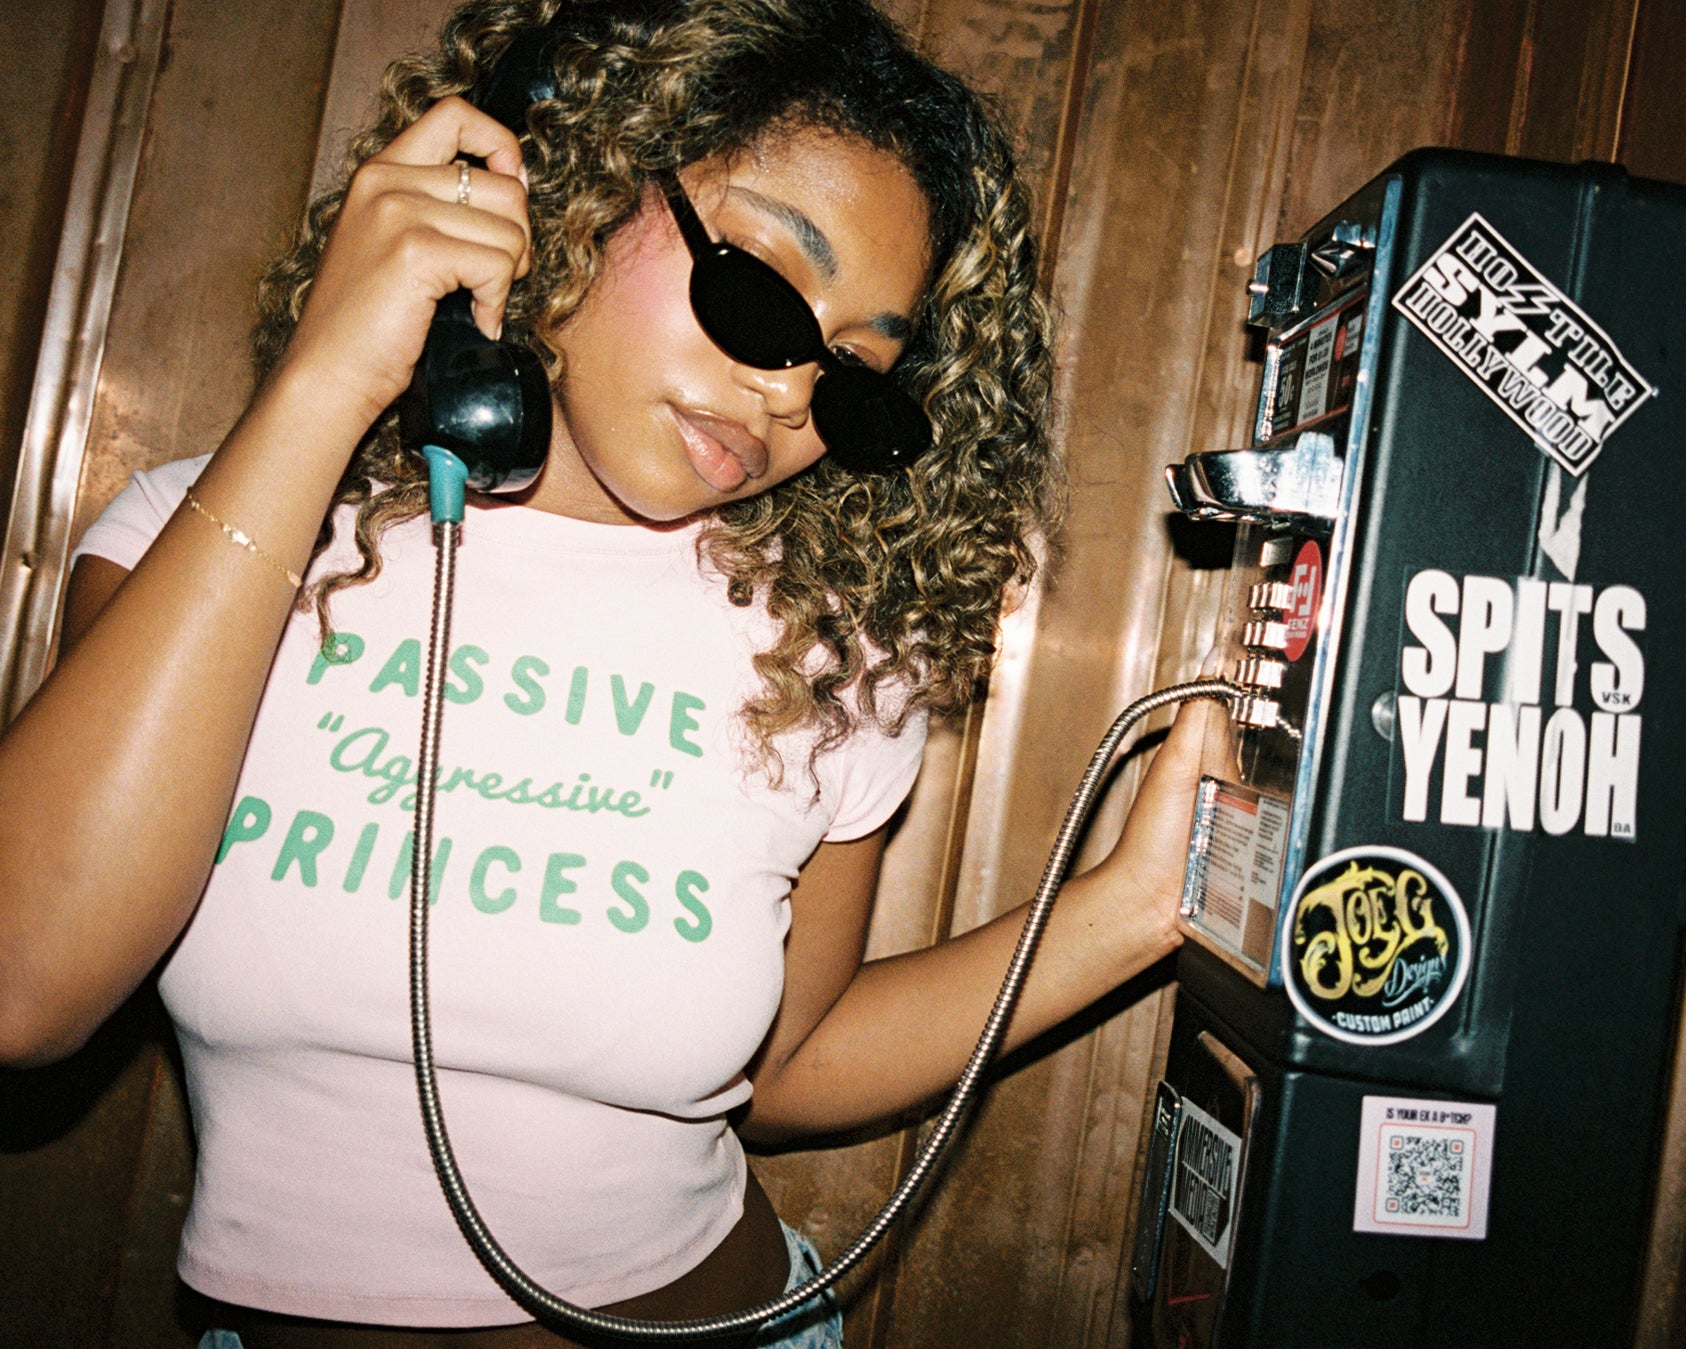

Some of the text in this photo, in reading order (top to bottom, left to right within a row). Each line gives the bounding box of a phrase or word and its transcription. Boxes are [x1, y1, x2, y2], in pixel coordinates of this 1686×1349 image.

[1405, 281, 1593, 461] HOLLYWOOD
[1422, 252, 1616, 444] SYLM
[306, 632, 707, 757] PASSIVE
[1401, 569, 1648, 713] SPITS
[1602, 692, 1631, 705] VSK
[1398, 695, 1643, 839] YENOH
[214, 796, 713, 943] PRINCESS
[1336, 996, 1430, 1032] CUSTOM PAINT
[1420, 1110, 1430, 1122] EX
